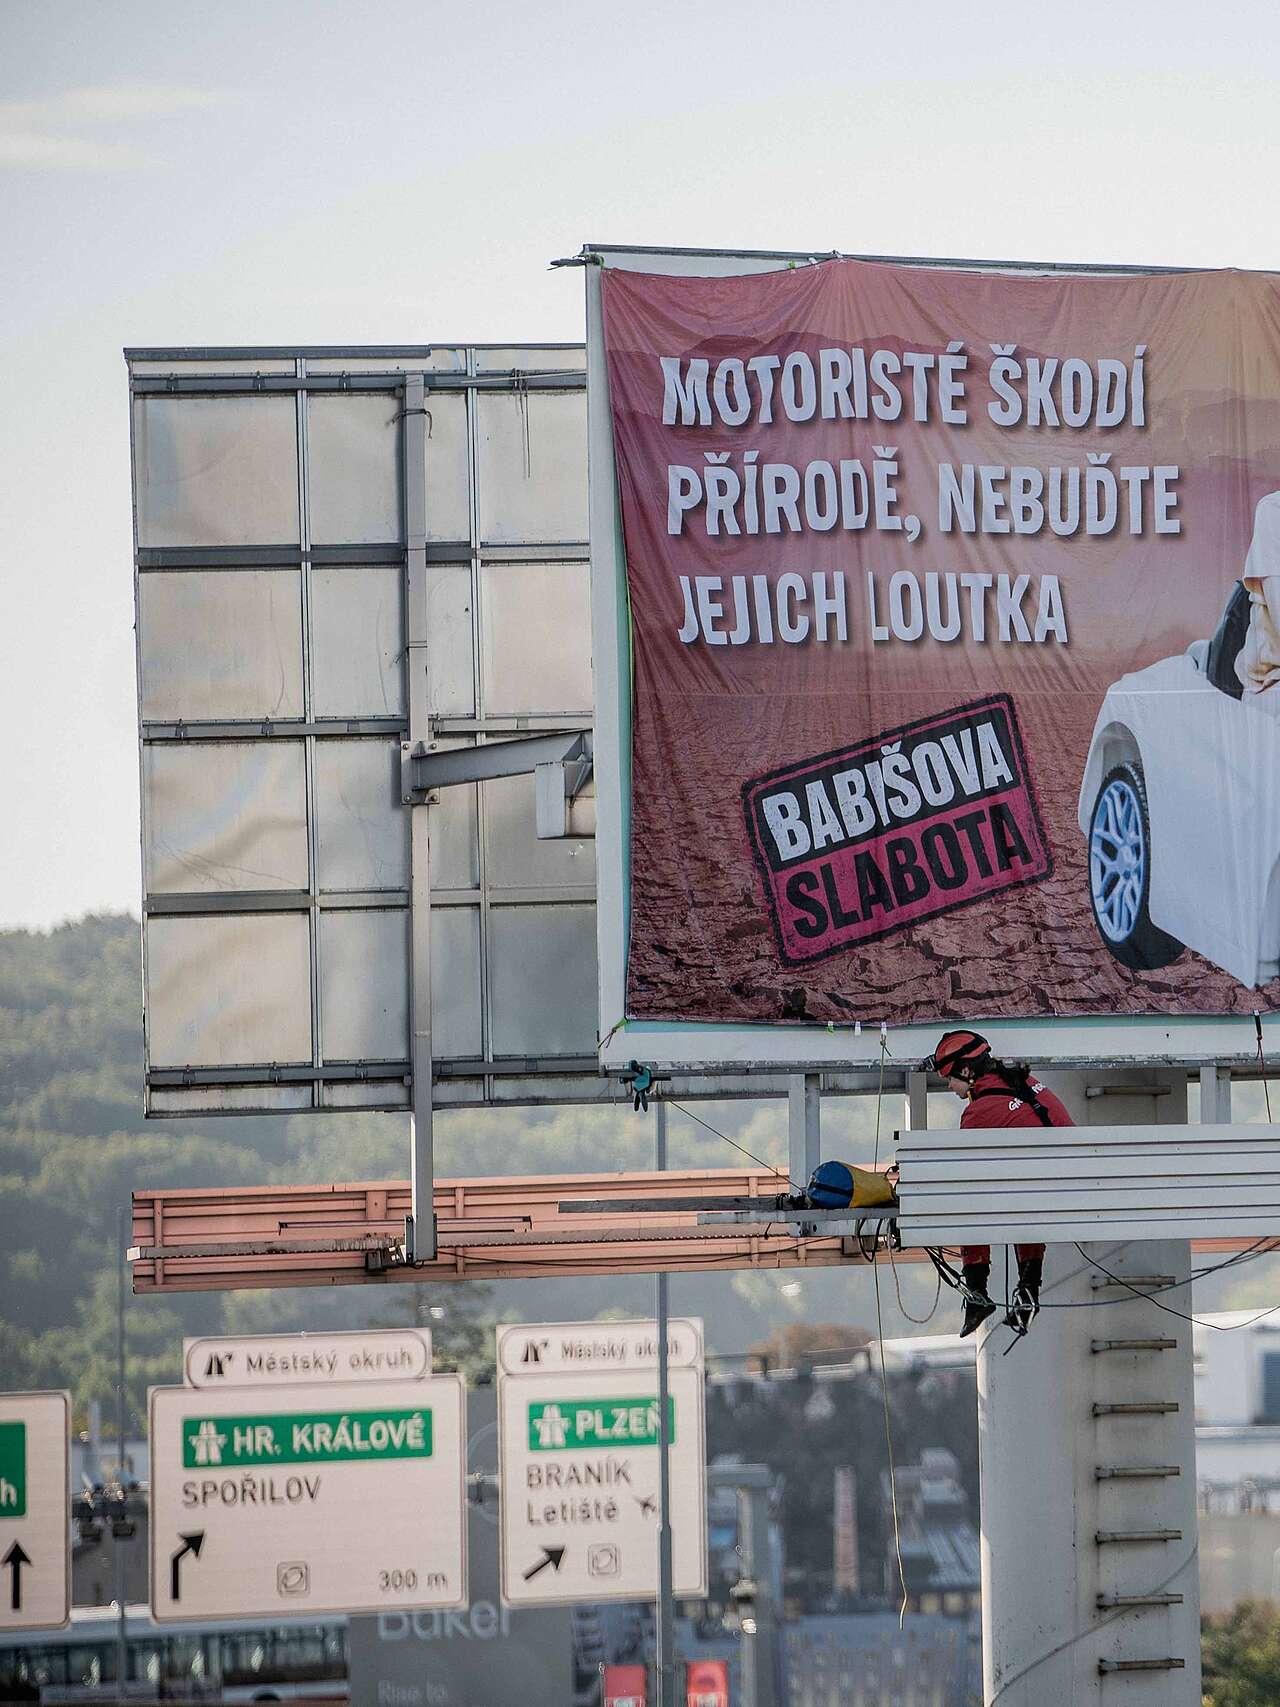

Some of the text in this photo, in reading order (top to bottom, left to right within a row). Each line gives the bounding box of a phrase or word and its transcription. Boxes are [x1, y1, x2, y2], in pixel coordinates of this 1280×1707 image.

[660, 341, 1148, 427] MOTORISTÉ ŠKODÍ
[667, 445, 1180, 543] PŘÍRODĚ, NEBUĎTE
[678, 570, 1068, 645] JEJICH LOUTKA
[761, 721, 1014, 862] BABIŠOVA
[785, 802, 1034, 938] SLABOTA
[246, 1348, 412, 1376] Městský okruh
[233, 1412, 426, 1457] HR. KRÁLOVÉ
[182, 1473, 322, 1508] SPOŘILOV
[526, 1456, 632, 1488] BRANÍK
[378, 1569, 448, 1592] 300 m
